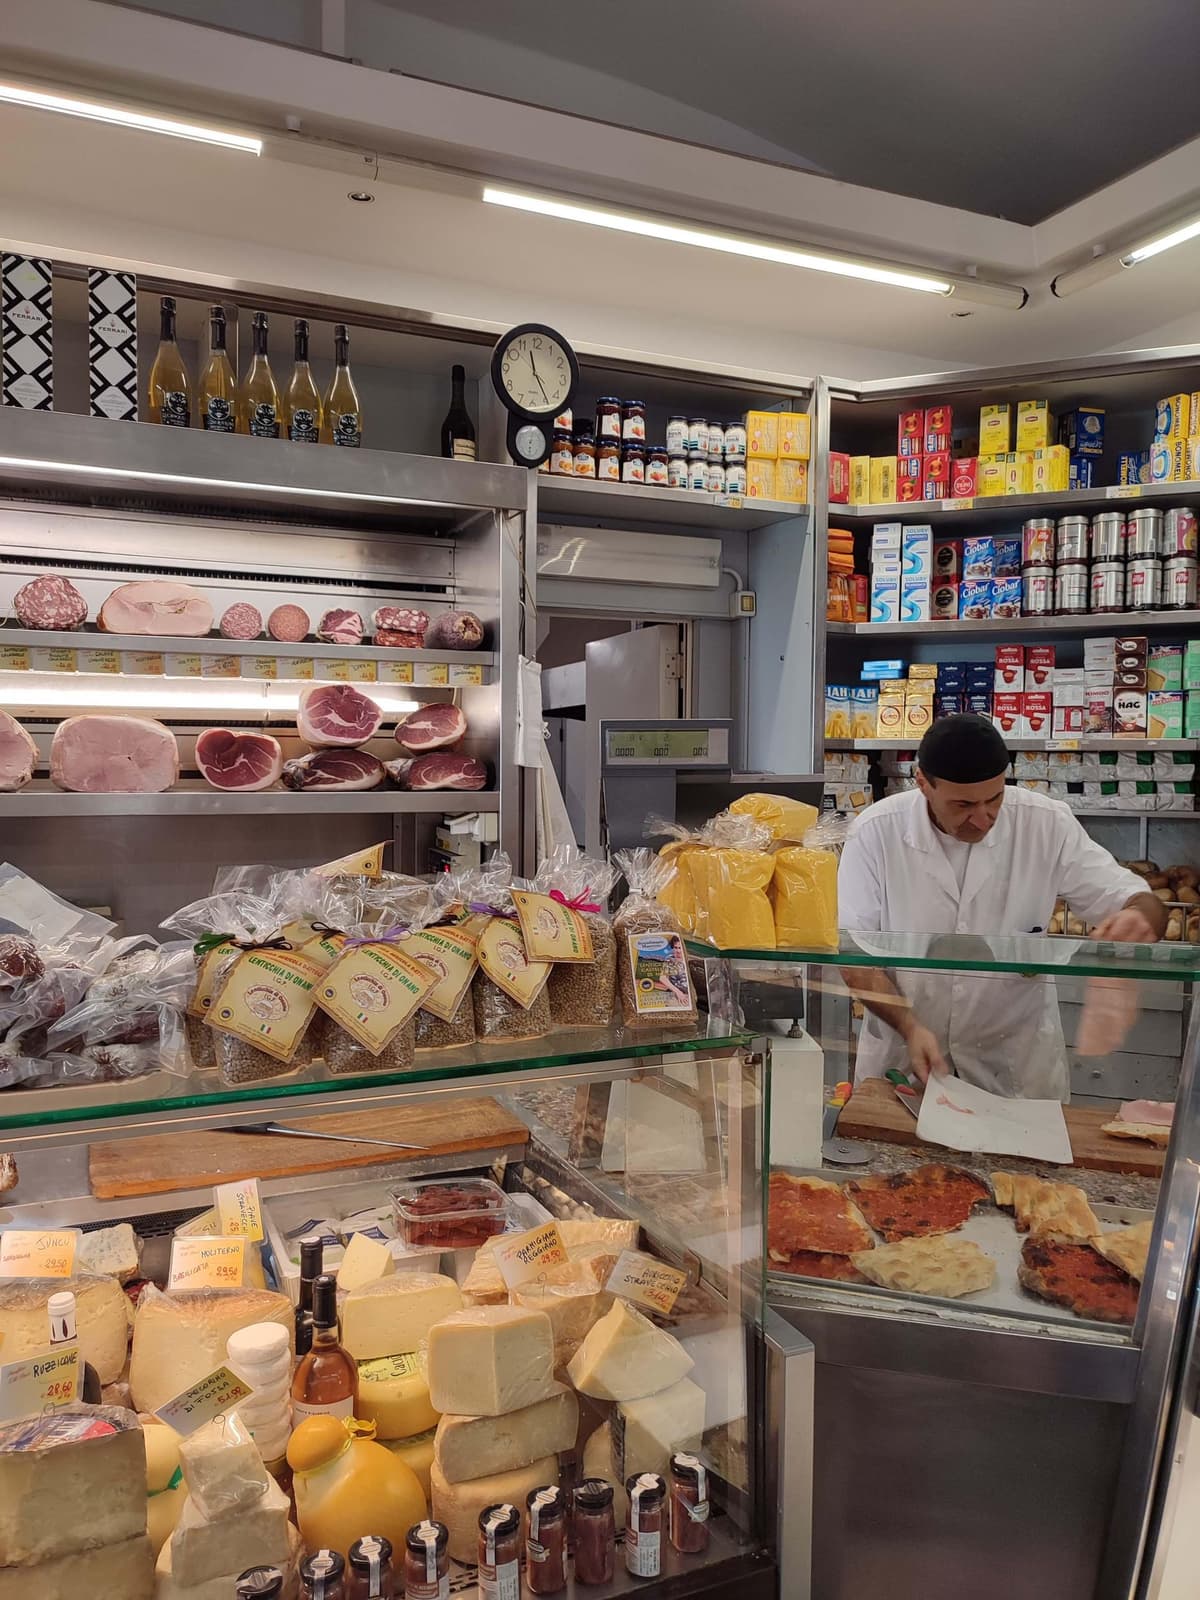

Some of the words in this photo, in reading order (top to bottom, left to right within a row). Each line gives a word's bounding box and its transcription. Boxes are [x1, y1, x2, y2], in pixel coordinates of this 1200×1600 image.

[12, 312, 43, 322] FERRARI
[98, 326, 128, 335] FERRARI
[518, 339, 527, 351] 11
[533, 337, 543, 350] 12
[506, 348, 520, 361] 10
[549, 345, 553, 356] 1
[503, 363, 510, 374] 9
[557, 357, 564, 369] 2
[506, 380, 513, 391] 8
[560, 374, 567, 386] 3
[518, 393, 525, 404] 7
[552, 390, 560, 399] 4
[964, 539, 990, 556] Ciobar
[962, 582, 990, 598] Ciobar
[992, 579, 1021, 596] Ciobar
[1118, 701, 1141, 709] HAG
[444, 942, 452, 950] DI
[451, 946, 472, 960] ONANO
[248, 956, 285, 977] LENTICCHIA
[285, 972, 293, 981] DI
[392, 969, 400, 978] DI
[399, 976, 420, 994] ONANO
[516, 1229, 556, 1260] PARMIGIANO
[523, 1238, 557, 1264] REGGIANO
[201, 1246, 240, 1258] MOLITERNO
[624, 1275, 678, 1294] STRAVECCHIO
[33, 1352, 77, 1378] RUZZICONE
[186, 1372, 226, 1398] PECORINO
[184, 1404, 195, 1413] DI
[194, 1381, 229, 1403] FOSSA
